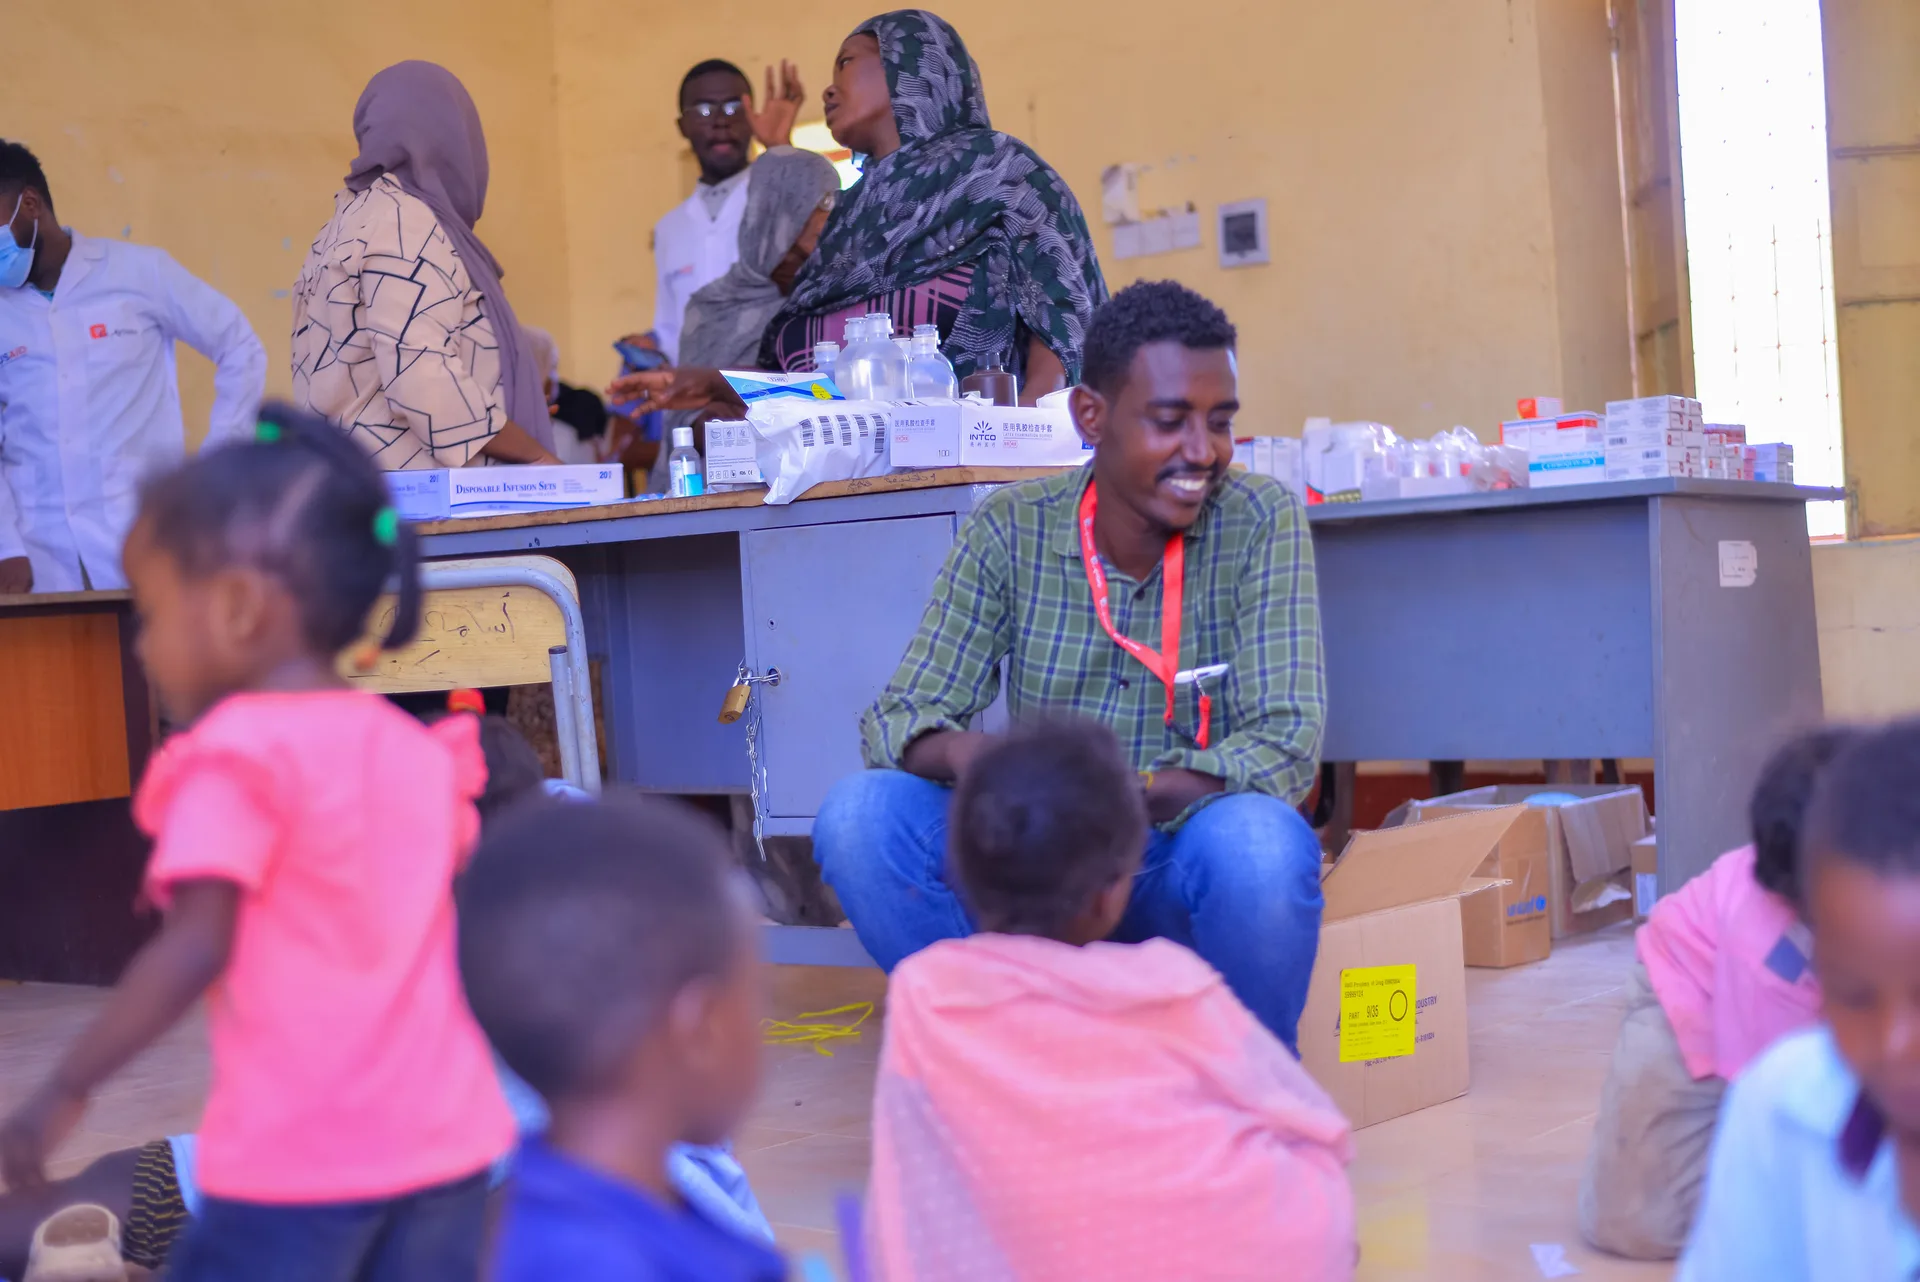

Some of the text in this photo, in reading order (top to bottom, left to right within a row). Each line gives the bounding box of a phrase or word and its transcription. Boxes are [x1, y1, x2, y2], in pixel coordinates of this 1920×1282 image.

[969, 433, 997, 441] INTCO
[599, 471, 608, 479] 20
[455, 484, 501, 494] DISPOSABLE
[503, 482, 537, 492] INFUSION
[538, 481, 557, 491] SETS
